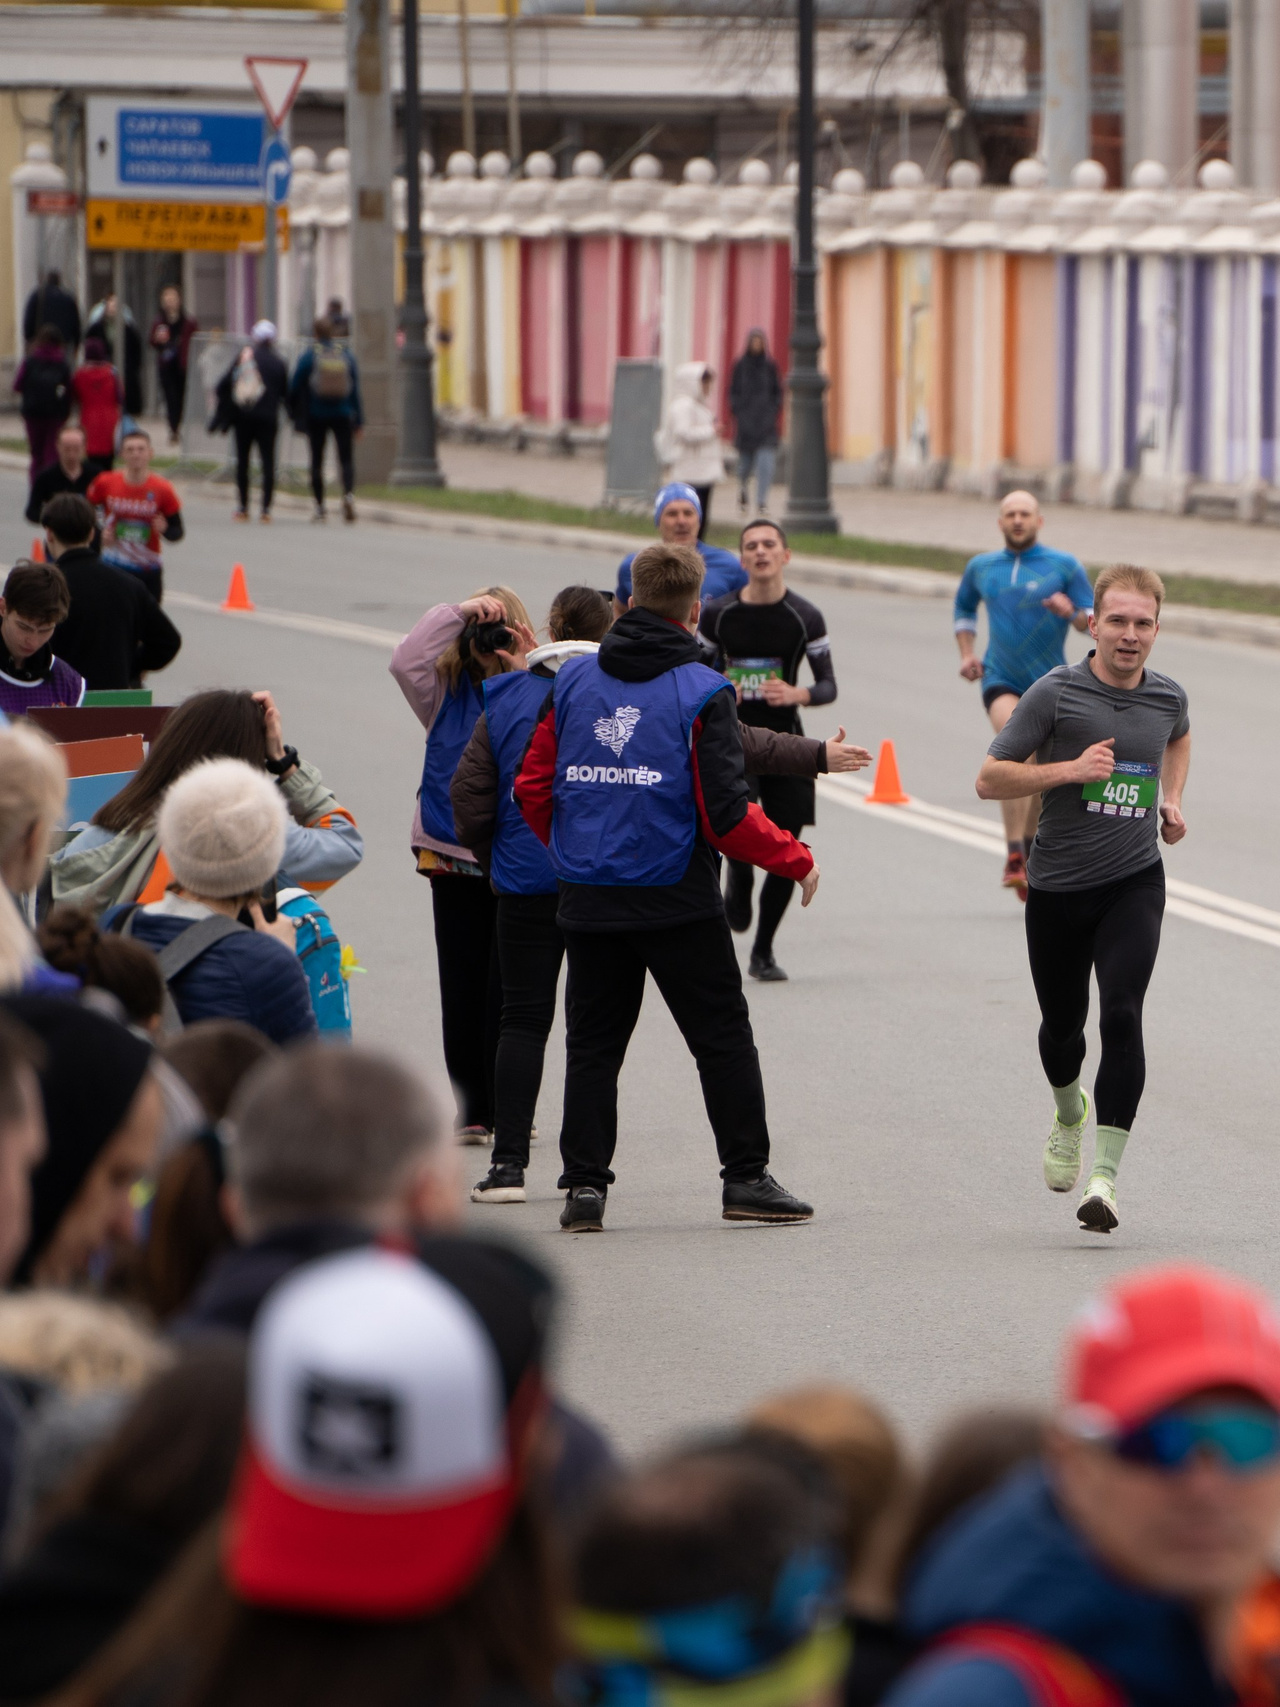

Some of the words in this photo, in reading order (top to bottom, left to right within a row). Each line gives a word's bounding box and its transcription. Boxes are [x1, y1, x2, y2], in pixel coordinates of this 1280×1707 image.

[117, 204, 252, 226] ПЕРЕПРАВА
[566, 765, 662, 786] ВОЛОНТЁР
[1103, 781, 1140, 805] 405
